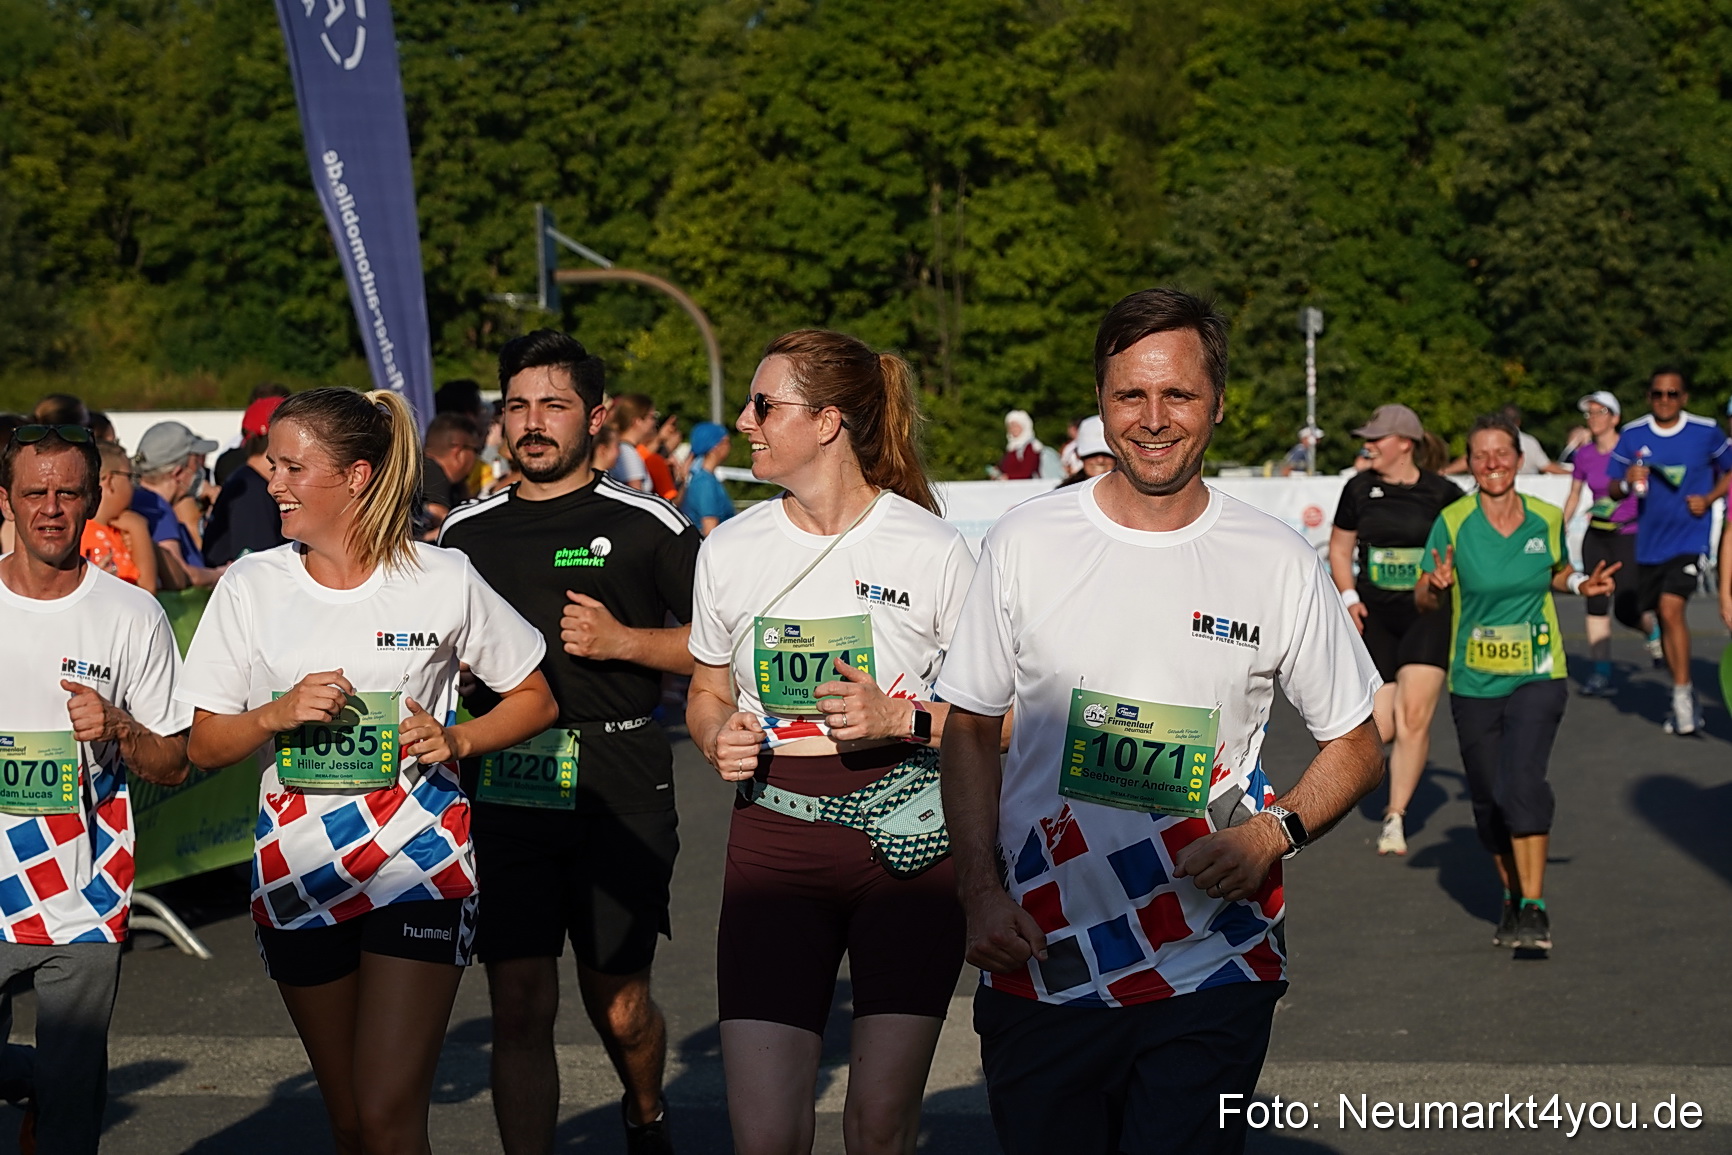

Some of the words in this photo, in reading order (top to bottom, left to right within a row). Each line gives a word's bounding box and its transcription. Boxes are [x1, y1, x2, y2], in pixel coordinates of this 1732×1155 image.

[554, 556, 605, 567] neumarkt
[555, 546, 589, 560] physio
[780, 635, 815, 644] Firmenlauf
[1191, 631, 1213, 641] Leading
[1215, 636, 1235, 645] FILTER
[1477, 642, 1522, 660] 1985
[760, 660, 771, 693] RUN
[781, 685, 809, 699] Jung
[1107, 716, 1154, 730] Firmenlauf
[1124, 727, 1152, 735] neumarkt
[281, 734, 292, 767] RUN
[293, 725, 378, 757] 1065
[381, 729, 393, 774] 2022
[297, 758, 326, 770] Hiller
[328, 758, 374, 770] Jessica
[495, 751, 559, 783] 1220
[1069, 739, 1087, 777] RUN
[1091, 732, 1186, 780] 1071
[3, 759, 59, 787] 070
[61, 763, 73, 802] 2022
[483, 758, 493, 787] RUN
[560, 761, 573, 798] 2022
[1081, 767, 1140, 788] Seeberger
[1141, 779, 1188, 794] Andreas
[1187, 752, 1207, 802] 2022
[0, 788, 20, 799] dam
[21, 789, 53, 799] Lucas
[403, 922, 453, 941] hummel
